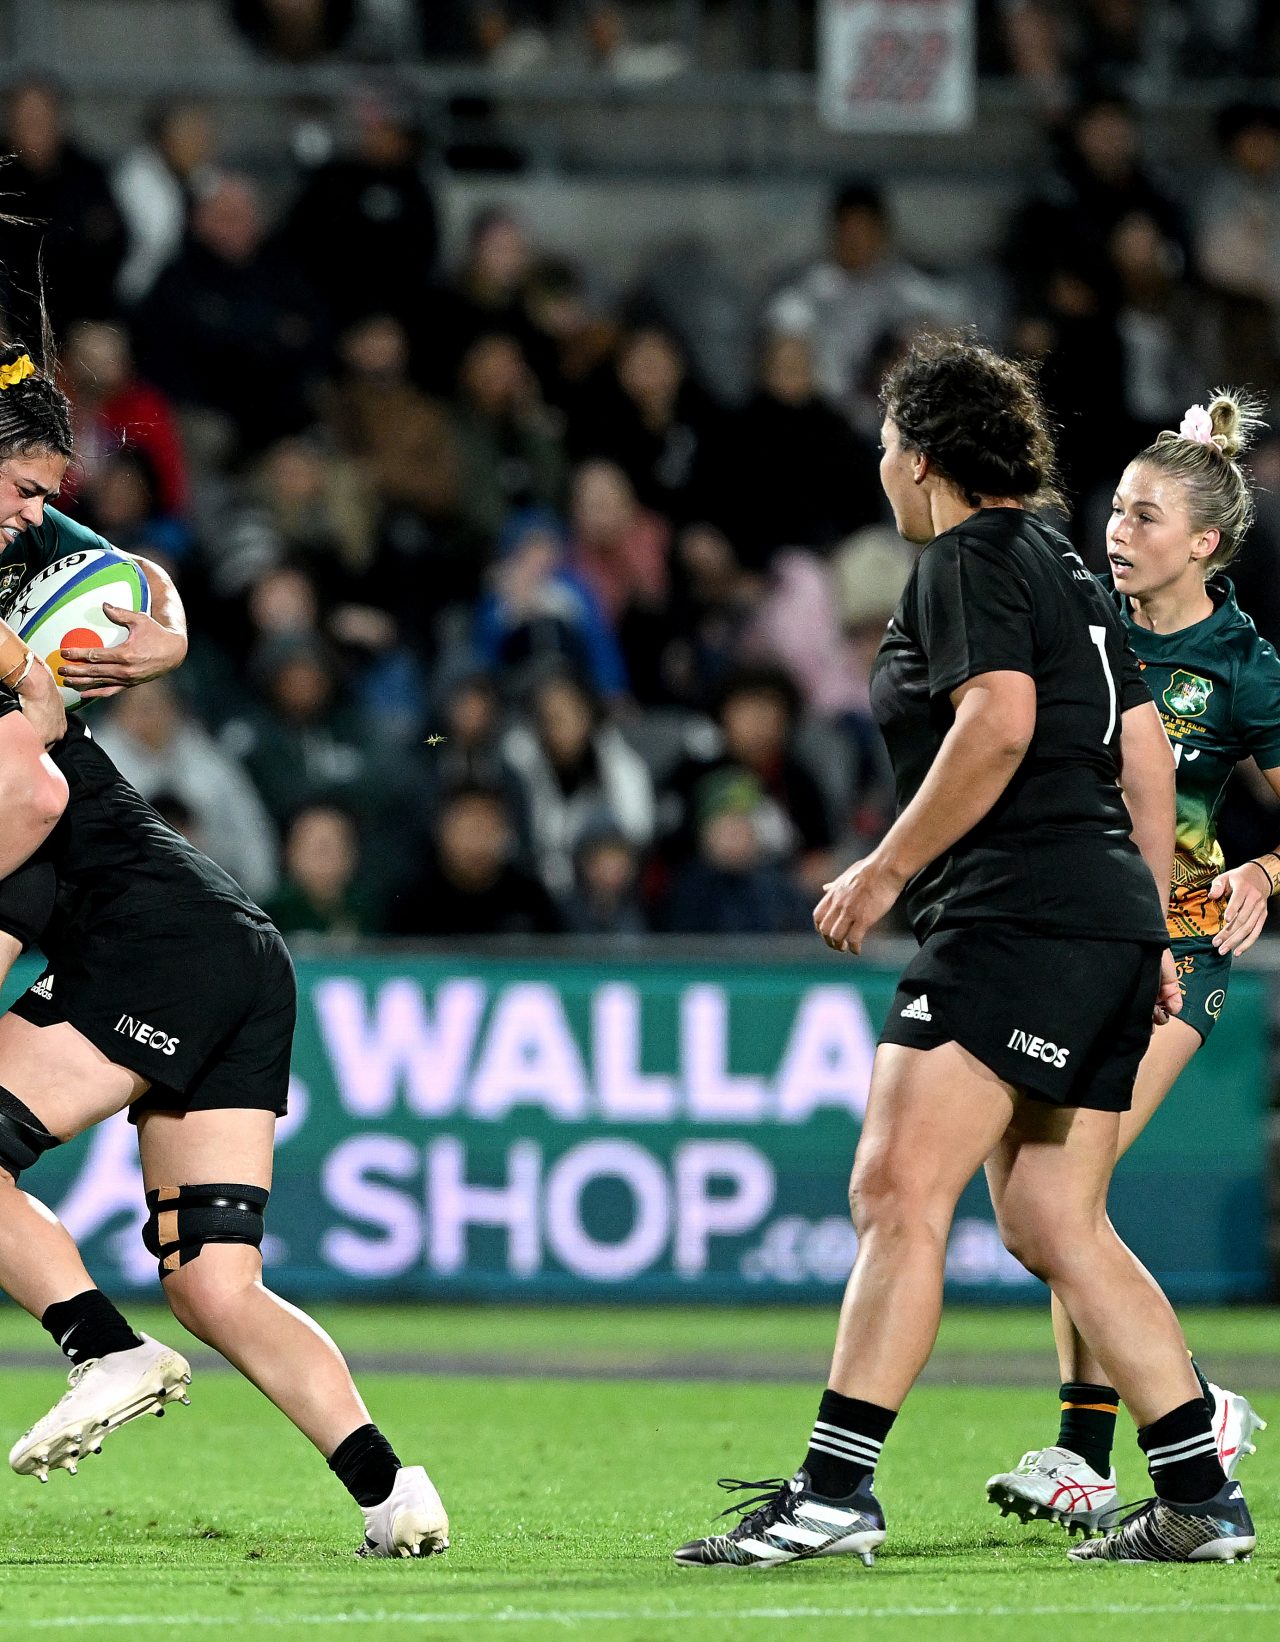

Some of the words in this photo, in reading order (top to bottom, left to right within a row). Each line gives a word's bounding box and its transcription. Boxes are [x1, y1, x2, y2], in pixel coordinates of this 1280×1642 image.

[113, 1014, 180, 1056] INEOS
[900, 1009, 932, 1022] adidas
[1006, 1028, 1070, 1069] INEOS
